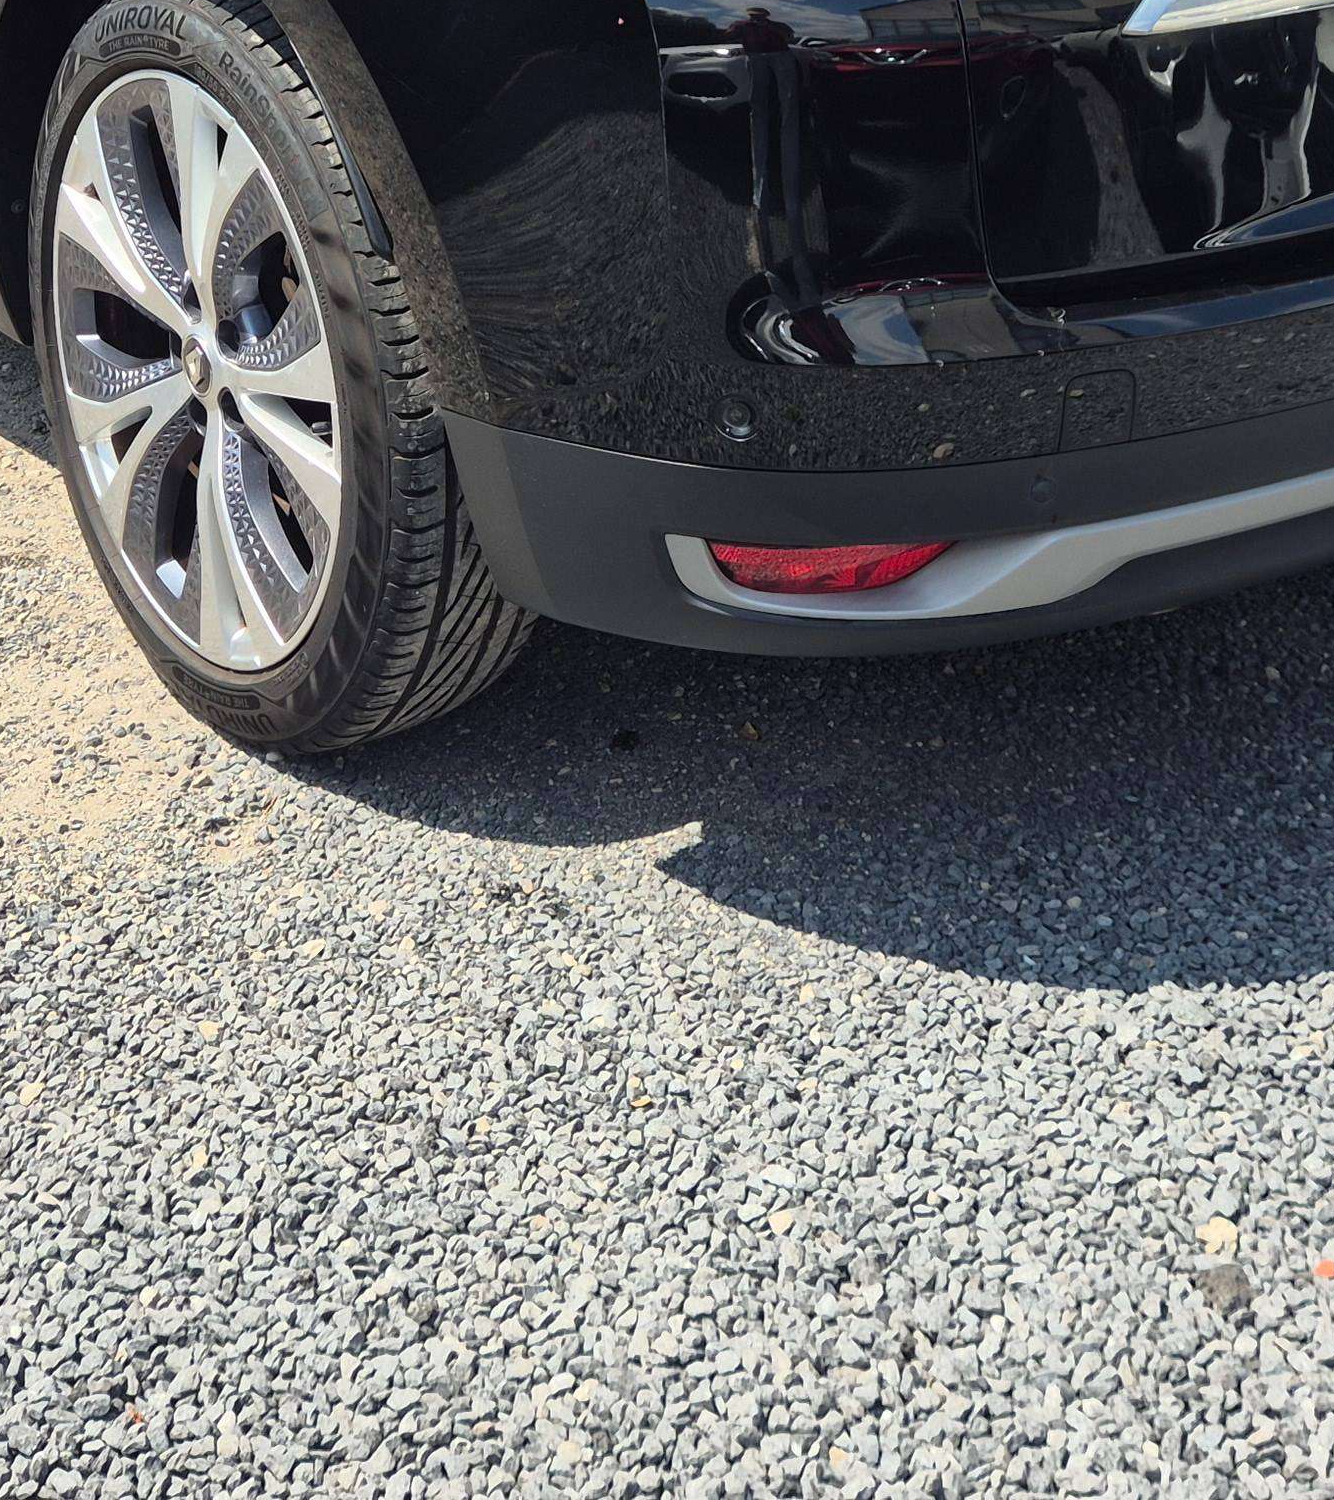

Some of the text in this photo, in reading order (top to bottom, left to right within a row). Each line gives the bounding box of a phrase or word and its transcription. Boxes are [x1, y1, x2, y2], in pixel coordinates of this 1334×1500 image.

[95, 5, 187, 42] UNIROYAL
[109, 40, 124, 53] THE
[148, 37, 170, 51] TYRE
